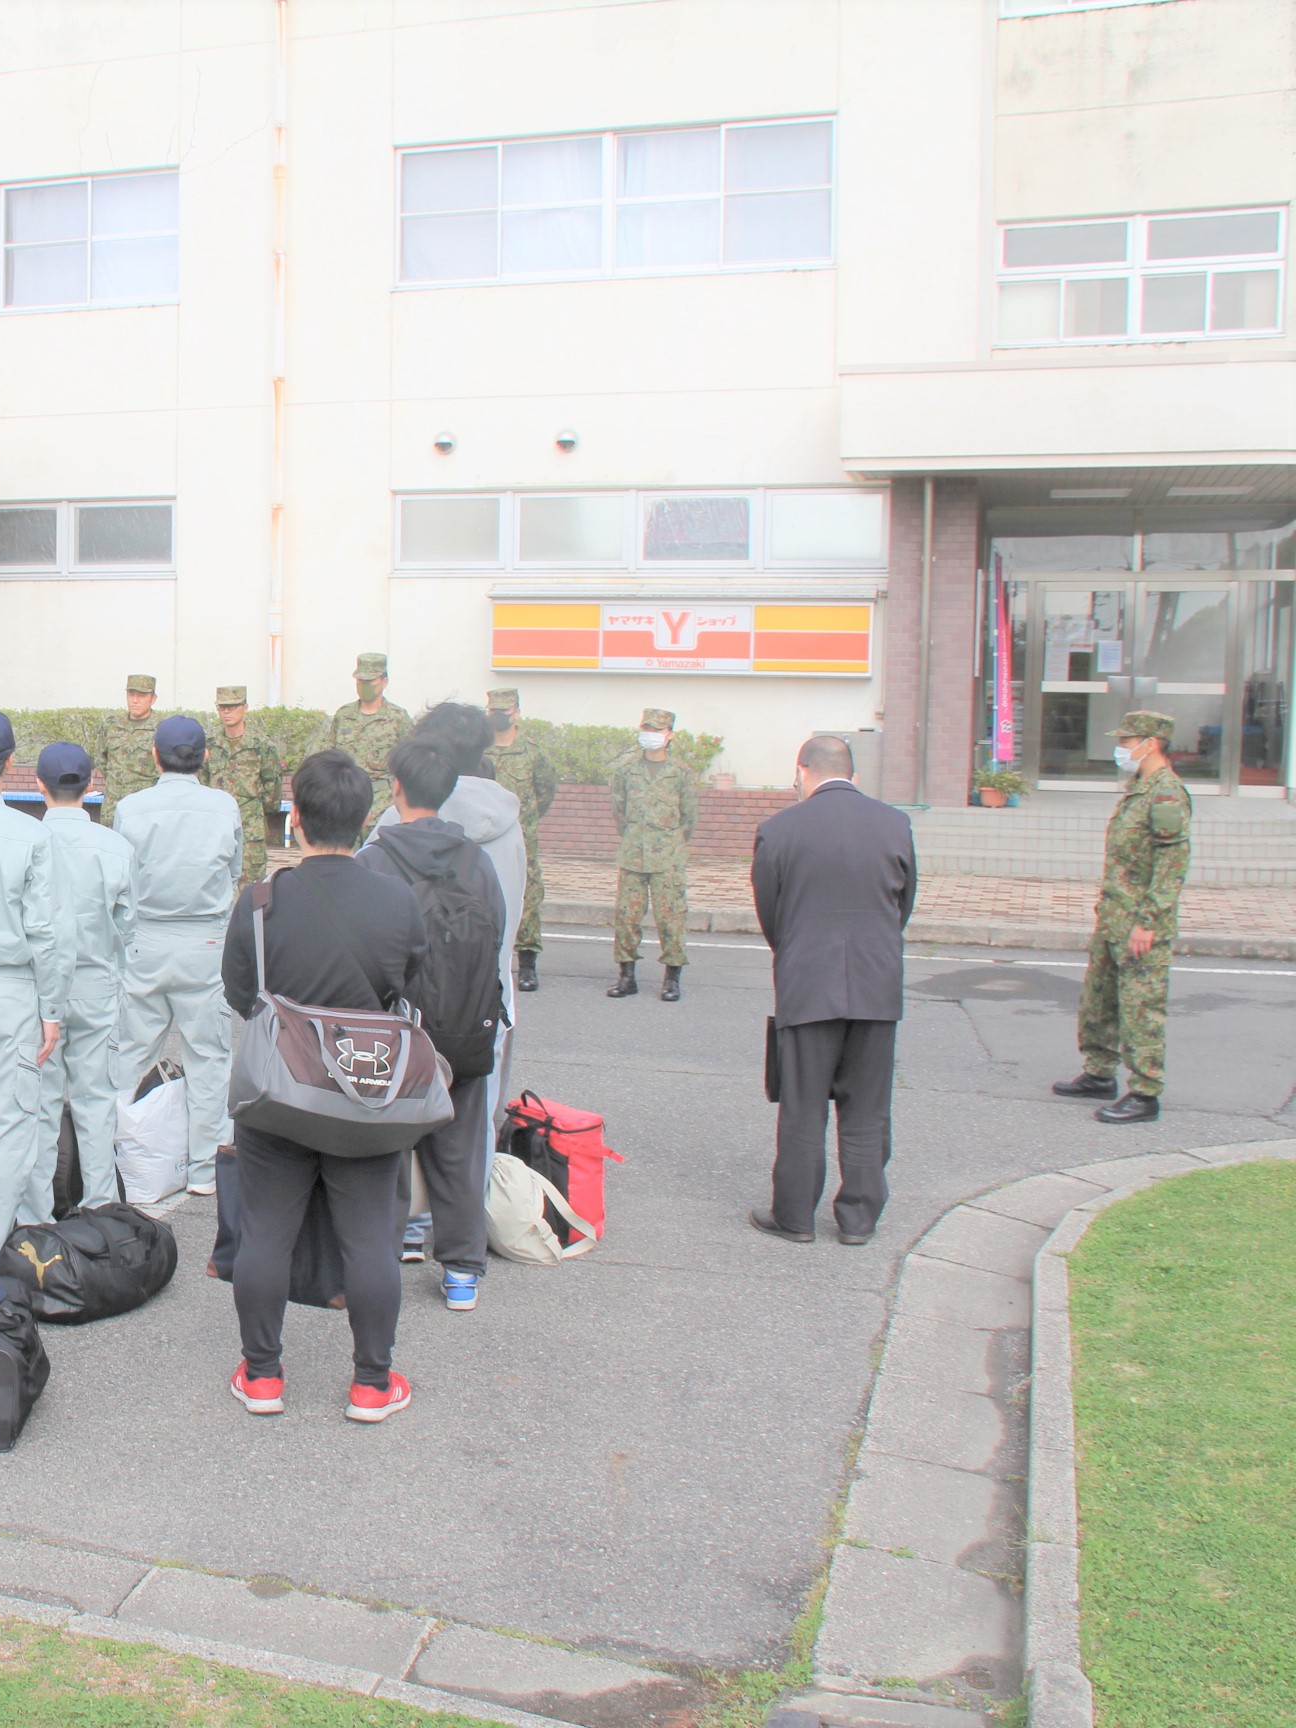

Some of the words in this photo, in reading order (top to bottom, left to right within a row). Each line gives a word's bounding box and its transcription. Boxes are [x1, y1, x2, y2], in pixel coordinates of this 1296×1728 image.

[608, 615, 655, 625] ヤマザキ
[696, 615, 737, 626] ショップ
[661, 611, 692, 645] Y
[657, 658, 706, 669] Yamazaki
[359, 1077, 393, 1087] ARMOU
